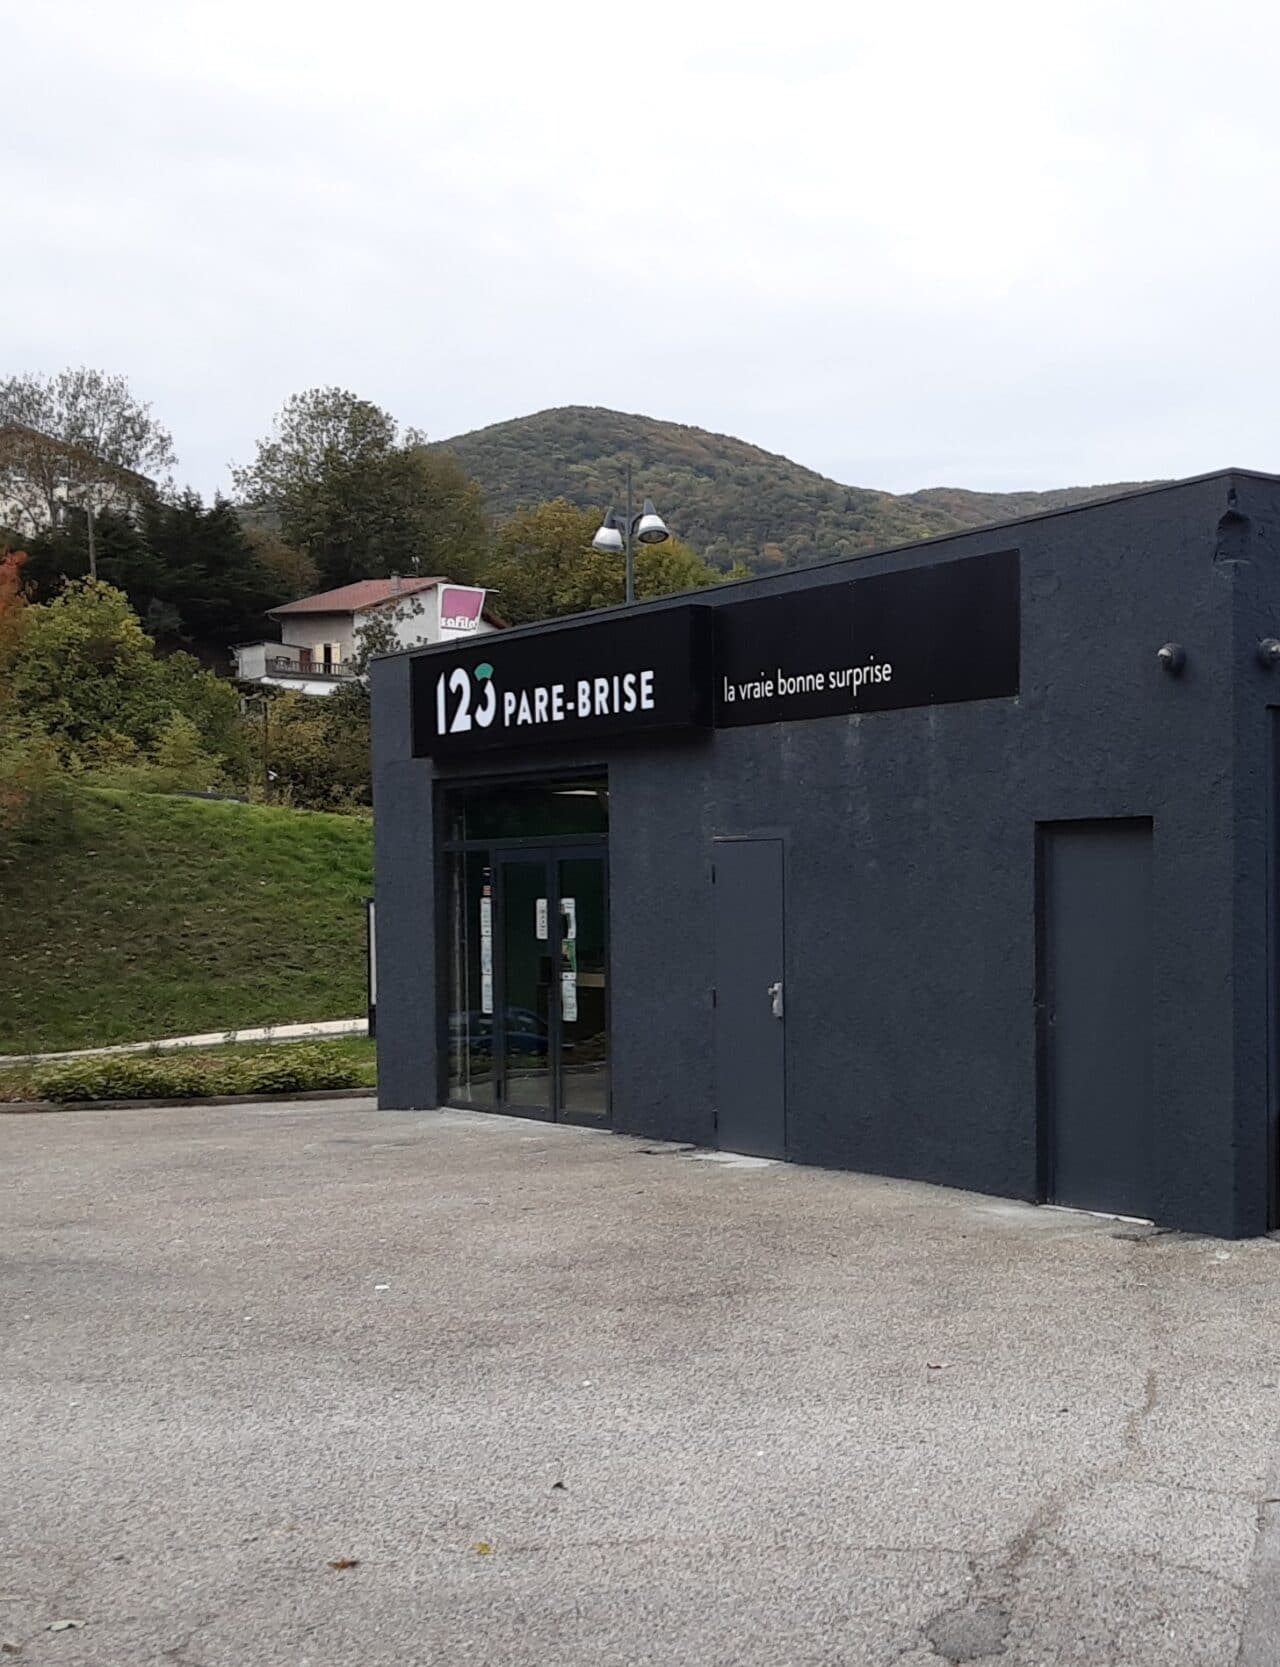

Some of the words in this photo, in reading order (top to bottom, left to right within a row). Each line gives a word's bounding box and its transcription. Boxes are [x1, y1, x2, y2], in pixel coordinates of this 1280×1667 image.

[436, 663, 497, 735] 123
[503, 670, 655, 727] PARE-BRISE
[724, 676, 736, 702] la
[738, 671, 774, 700] vraie
[777, 668, 825, 696] bonne
[828, 655, 893, 697] surprise
